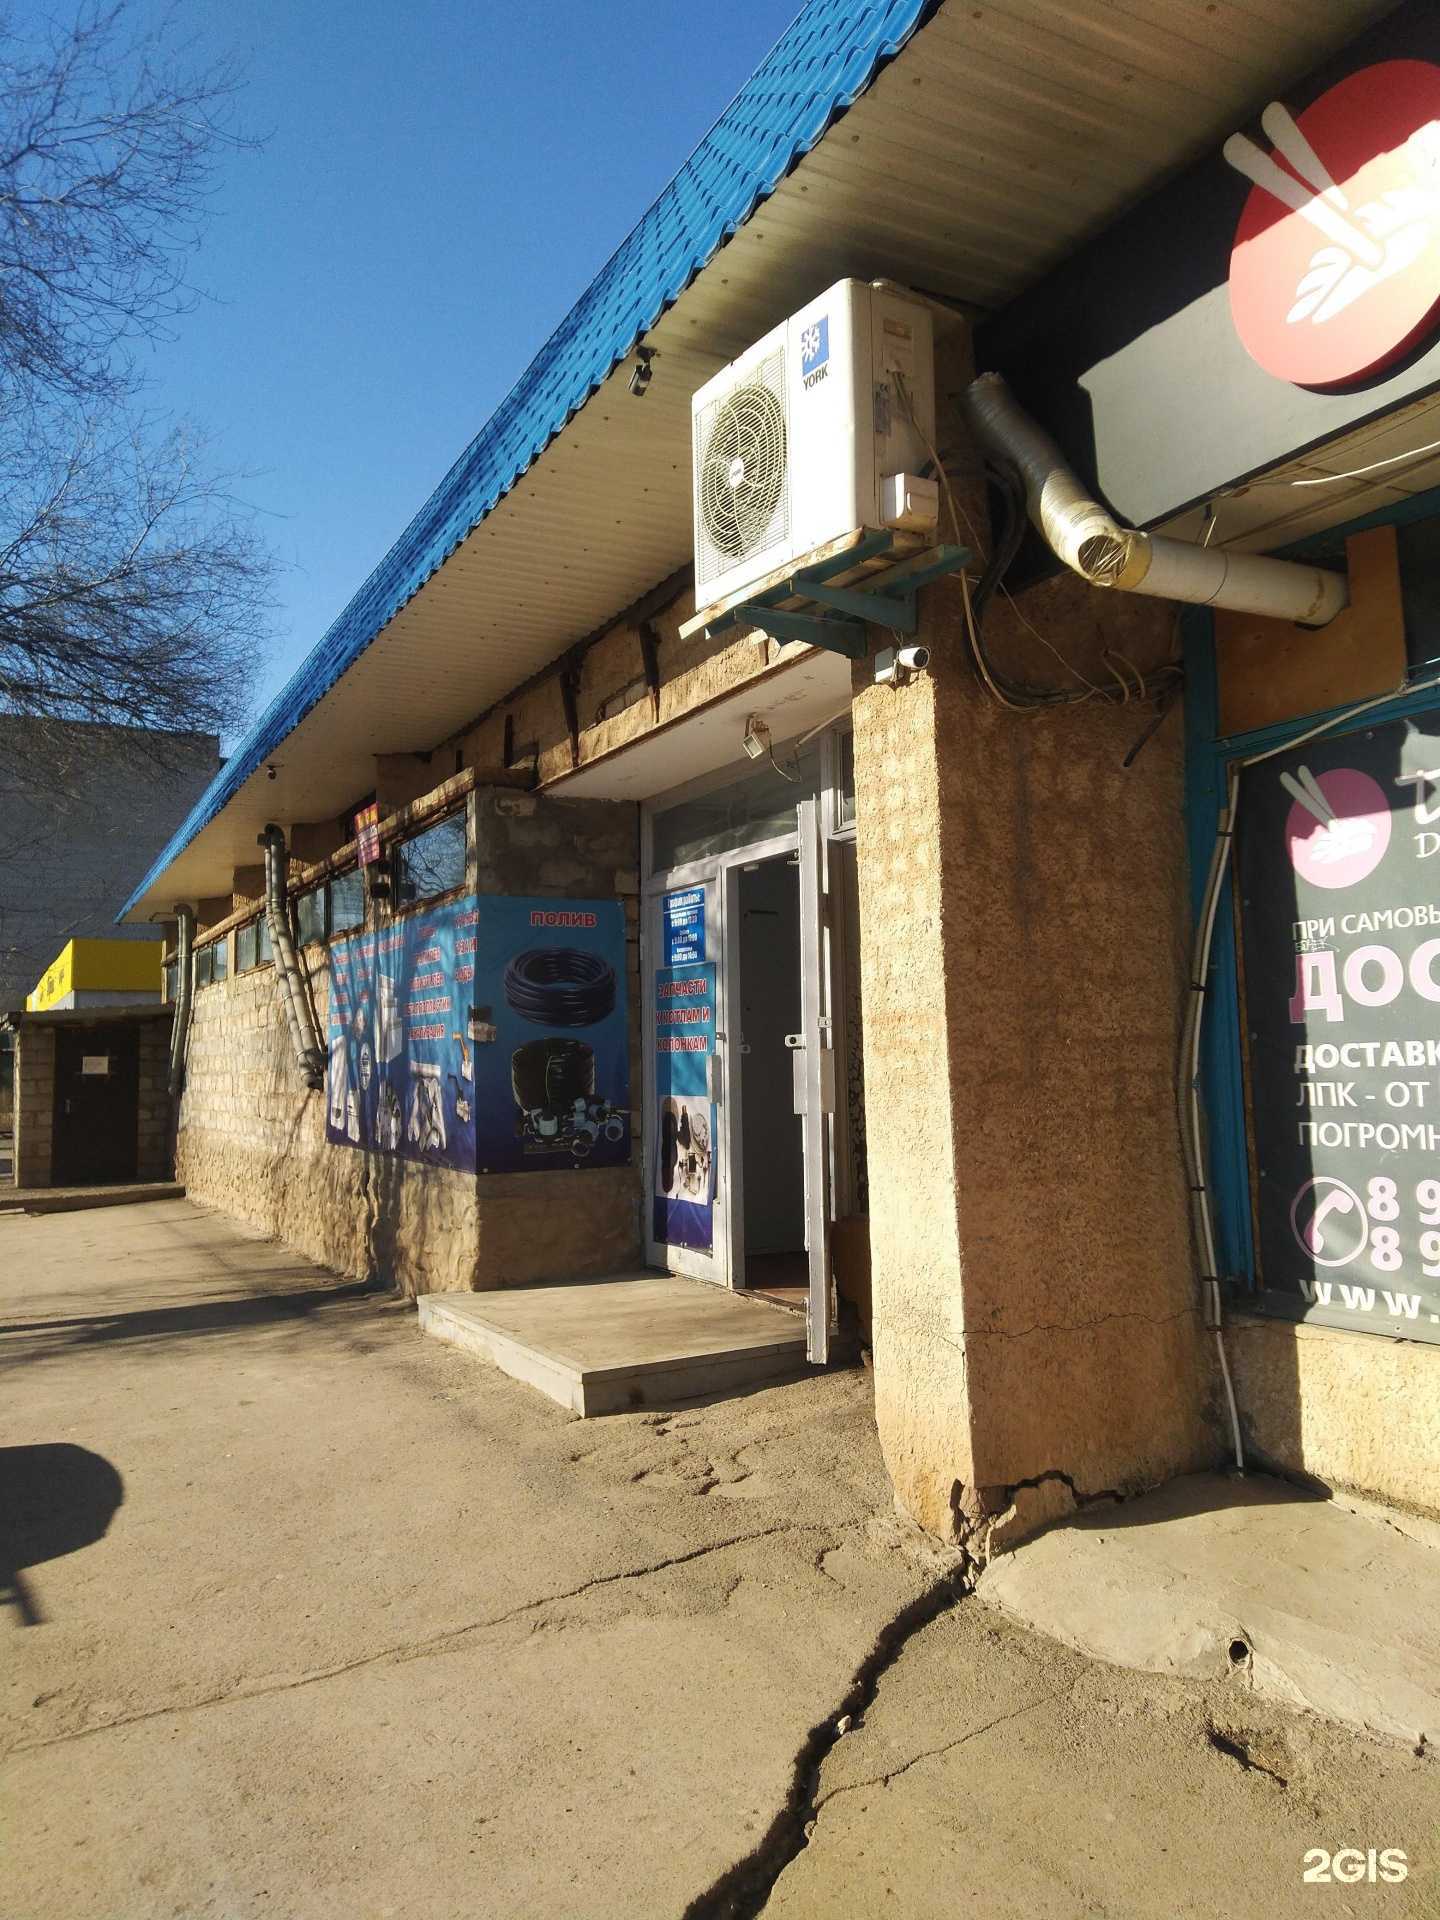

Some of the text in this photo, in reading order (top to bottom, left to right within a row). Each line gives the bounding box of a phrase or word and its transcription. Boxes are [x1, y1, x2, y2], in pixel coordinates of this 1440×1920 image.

[803, 363, 828, 391] YORK
[530, 911, 598, 928] ПОЛИВ
[1292, 917, 1336, 941] ПРИ
[658, 979, 706, 998] ЗАПЧАСТИ
[656, 1036, 708, 1052] КОЛОНКАМ
[1384, 1081, 1430, 1107] ОТ
[1367, 1176, 1400, 1221] 8
[1370, 1226, 1403, 1272] 8
